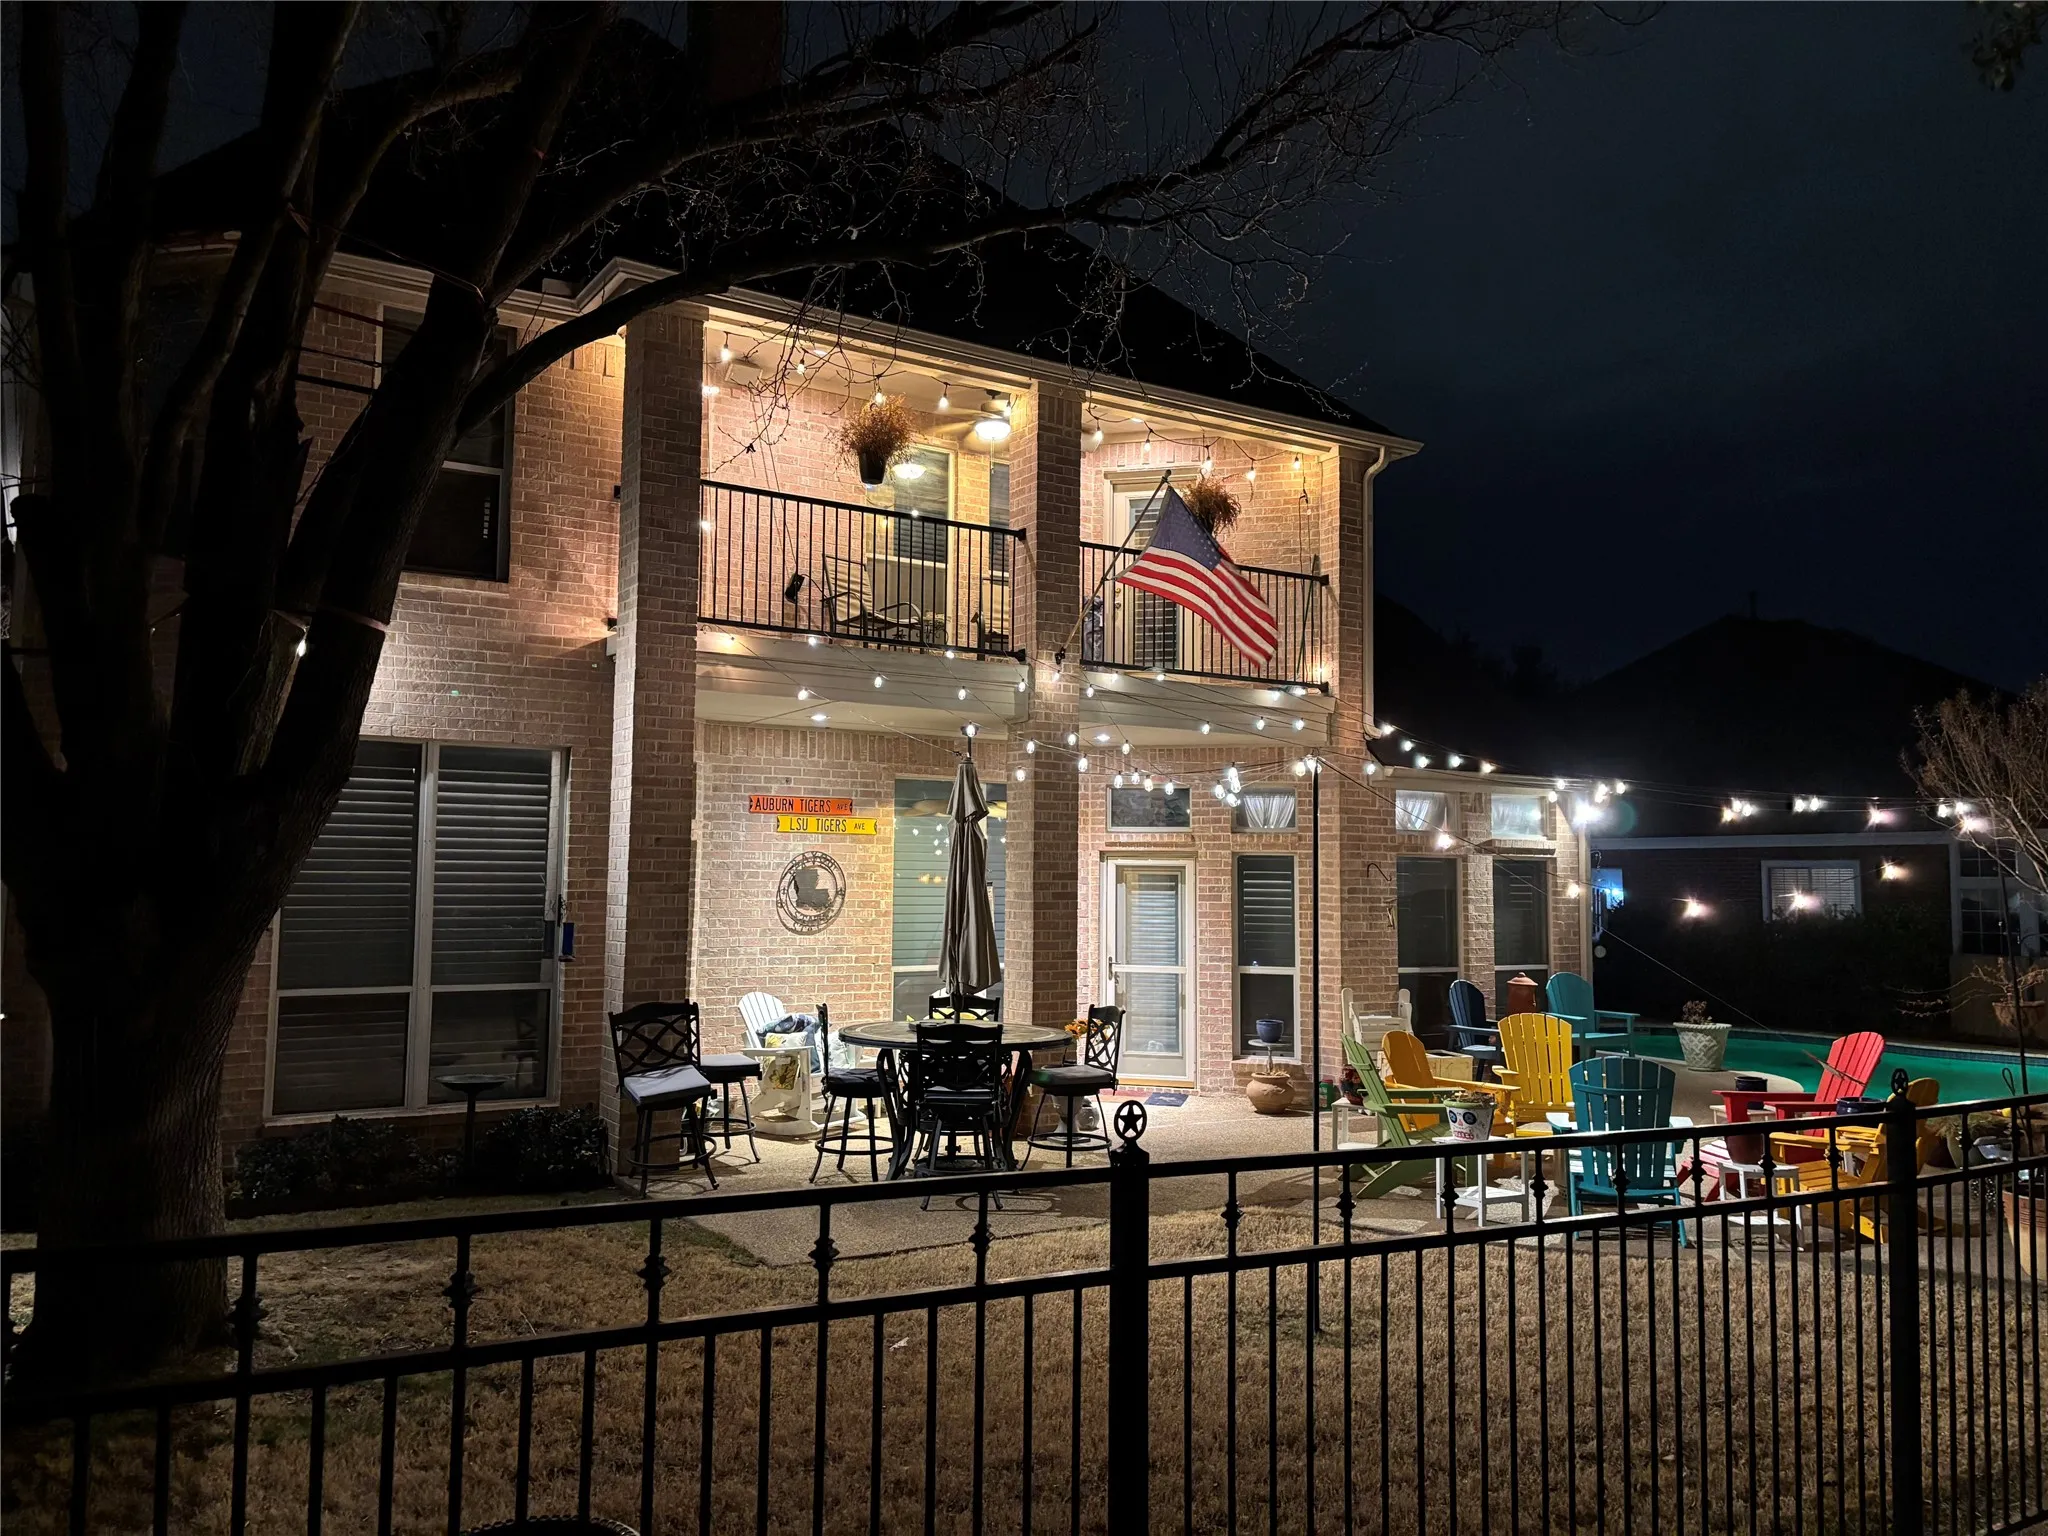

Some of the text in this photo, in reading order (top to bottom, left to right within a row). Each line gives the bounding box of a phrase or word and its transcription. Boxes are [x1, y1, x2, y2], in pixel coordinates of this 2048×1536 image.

[754, 797, 794, 812] AUBURN
[800, 798, 831, 813] TIGERS
[790, 817, 866, 832] LSU TIGERS AVE
